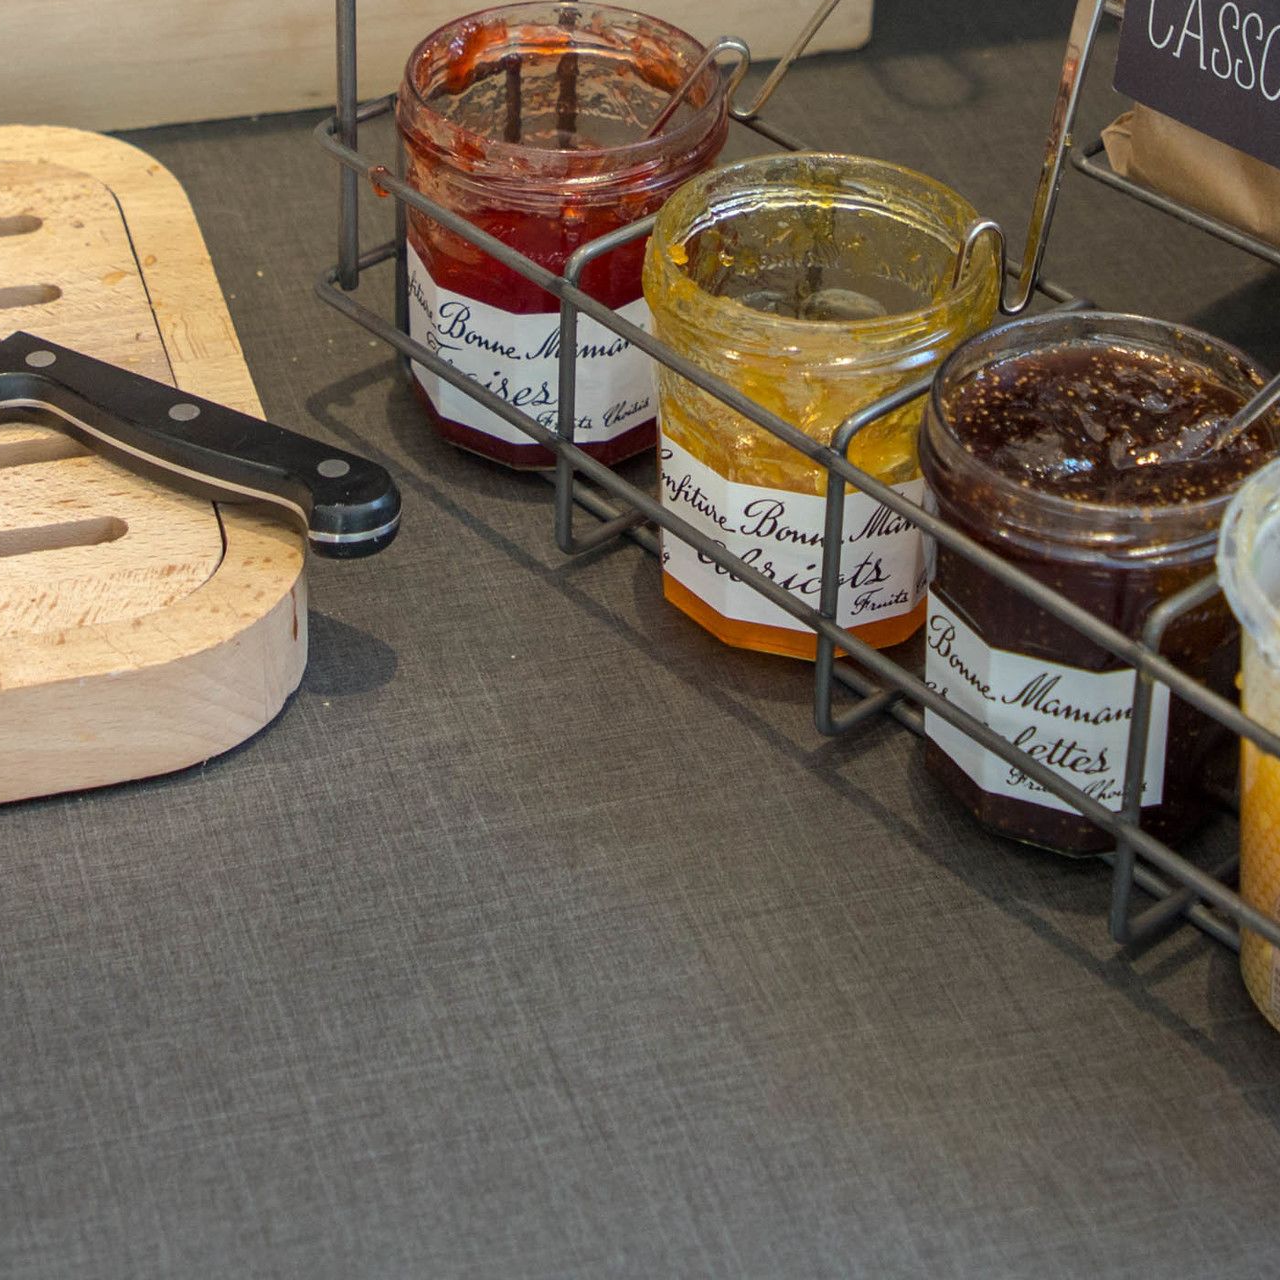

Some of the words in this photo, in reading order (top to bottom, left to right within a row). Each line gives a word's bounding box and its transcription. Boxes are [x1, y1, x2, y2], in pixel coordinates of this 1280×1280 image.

[437, 301, 522, 360] Bonne
[850, 587, 910, 616] Fruits
[928, 614, 996, 701] Bonne
